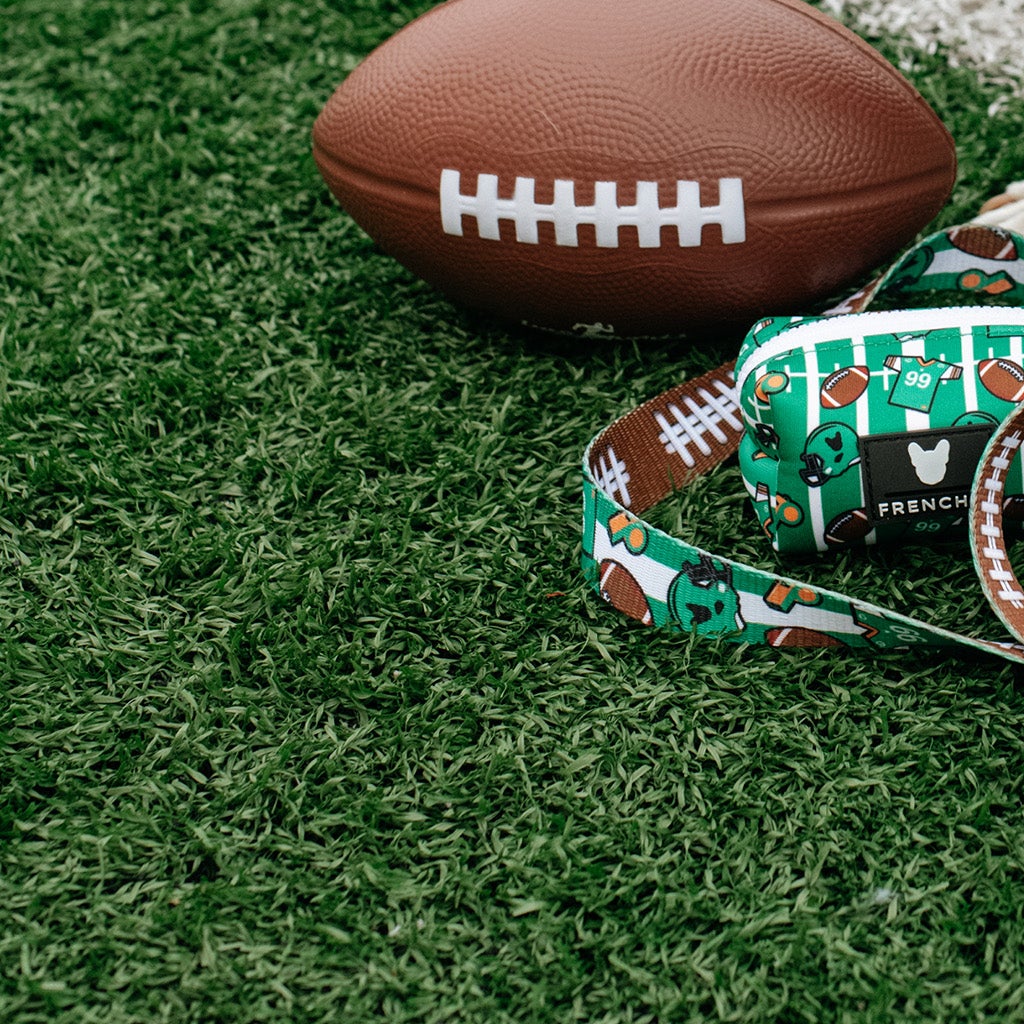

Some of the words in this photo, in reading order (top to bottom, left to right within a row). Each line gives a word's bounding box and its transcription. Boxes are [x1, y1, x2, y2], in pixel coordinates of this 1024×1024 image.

[904, 370, 932, 389] 99
[878, 494, 969, 517] FRENCH
[914, 521, 941, 533] 99
